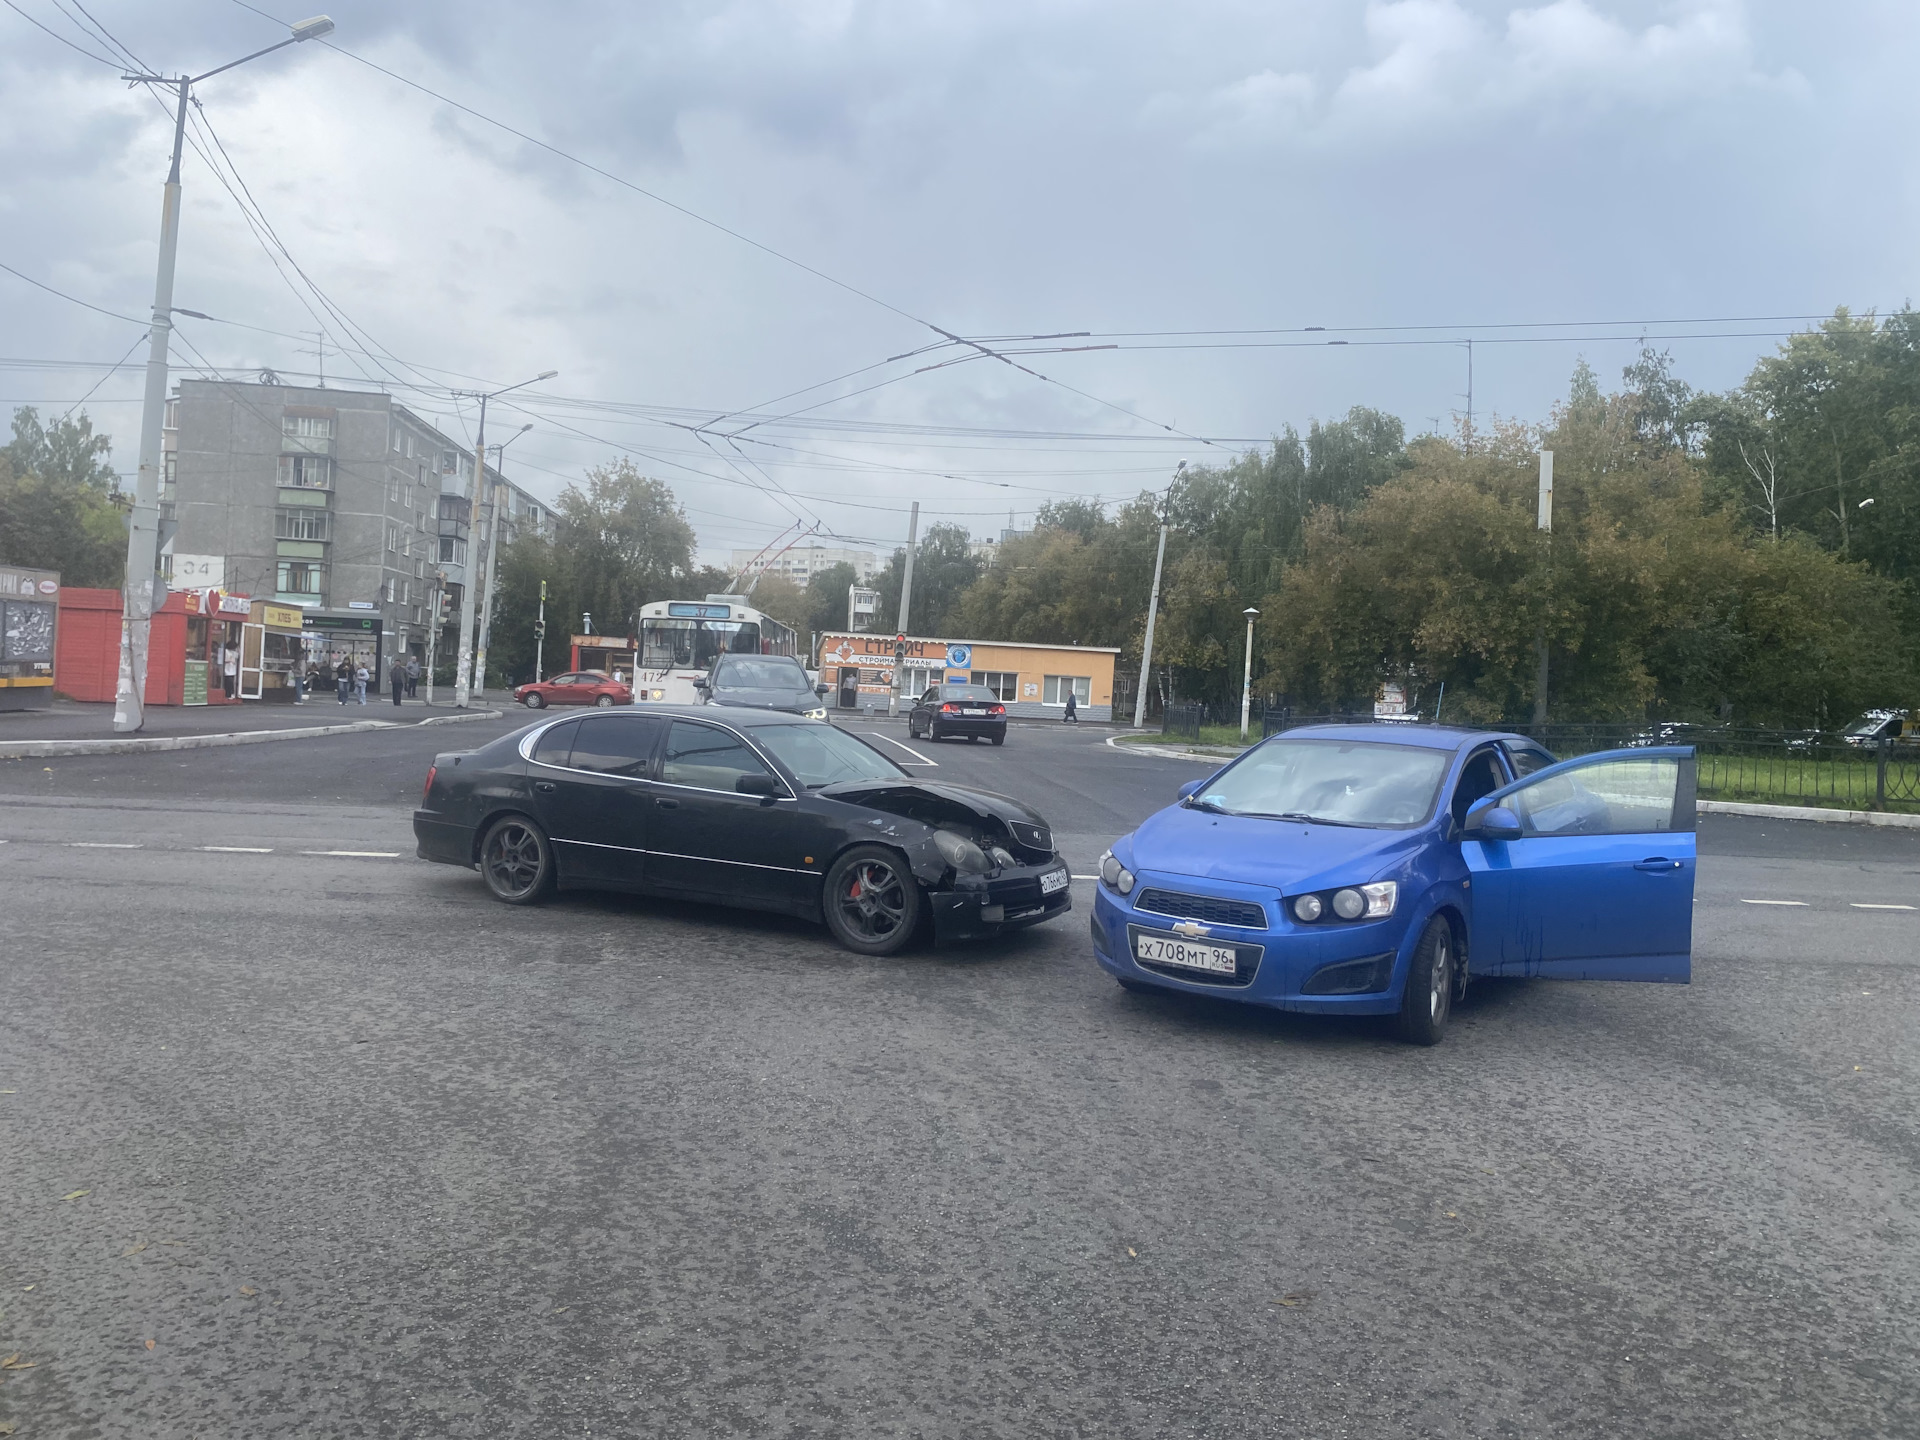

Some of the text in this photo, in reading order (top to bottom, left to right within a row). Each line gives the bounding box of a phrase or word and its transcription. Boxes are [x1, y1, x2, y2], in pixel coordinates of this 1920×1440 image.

[184, 561, 209, 575] 34
[695, 607, 708, 617] 37
[865, 640, 924, 656] СТРИЧ
[858, 656, 931, 666] СТРОЙМАРИАЛЫ
[641, 672, 663, 683] 472
[1144, 940, 1229, 965] Х708МТ 96
